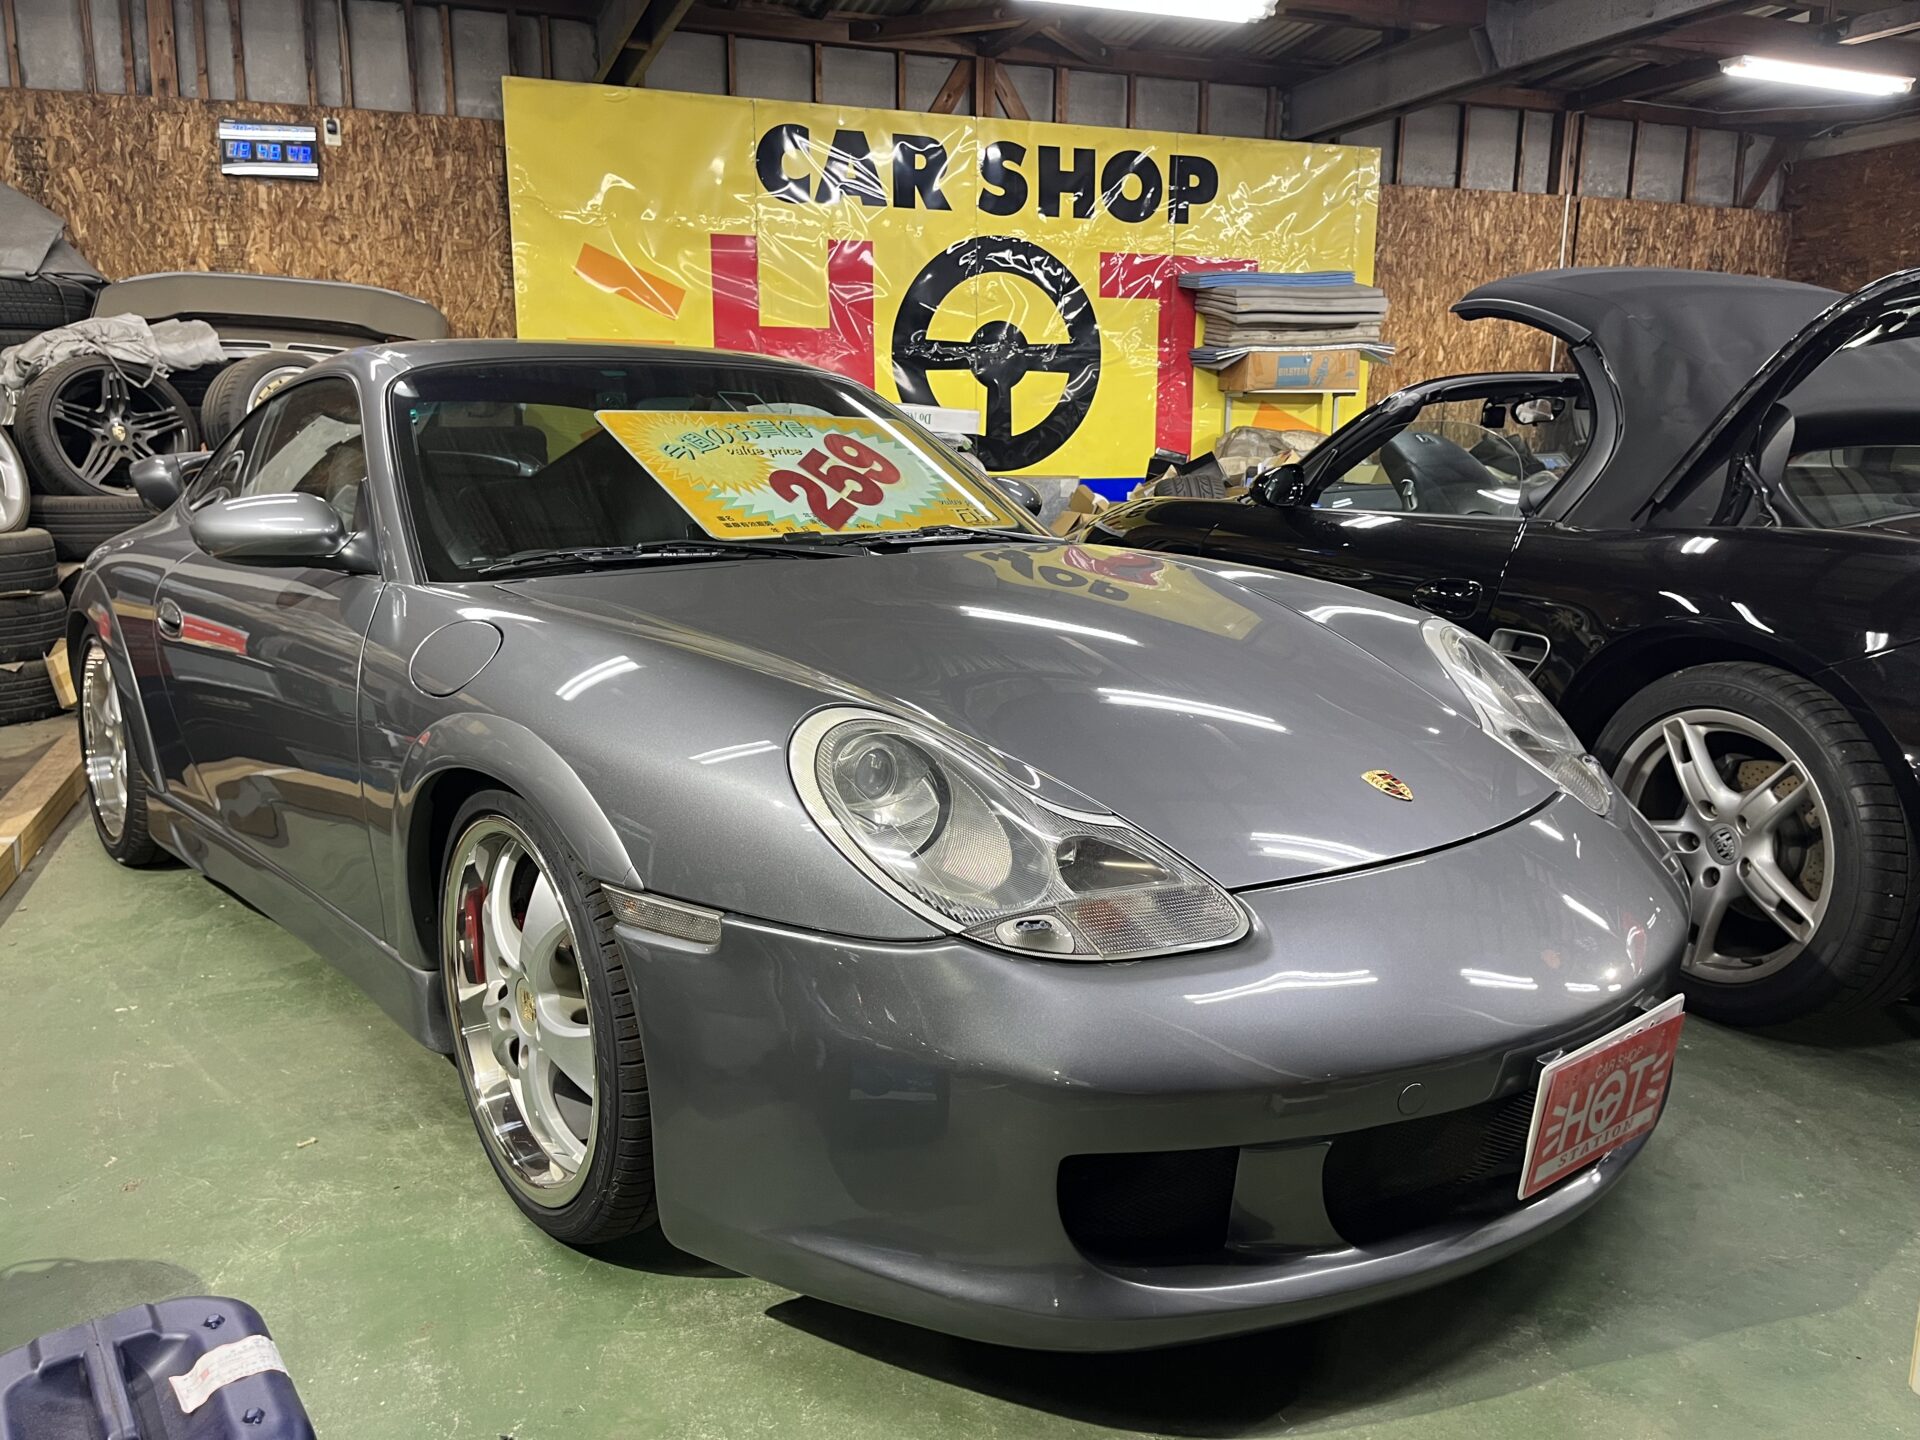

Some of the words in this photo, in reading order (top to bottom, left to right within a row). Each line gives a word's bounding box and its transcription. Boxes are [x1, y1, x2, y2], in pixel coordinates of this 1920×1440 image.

[755, 124, 951, 211] CAR
[977, 140, 1219, 224] SHOP
[726, 445, 766, 456] value
[767, 447, 804, 458] price
[768, 433, 900, 532] 259
[1596, 1060, 1616, 1078] CAR
[1617, 1046, 1643, 1070] SHOP
[1557, 1053, 1656, 1155] HOT
[1558, 1118, 1636, 1168] STATION
